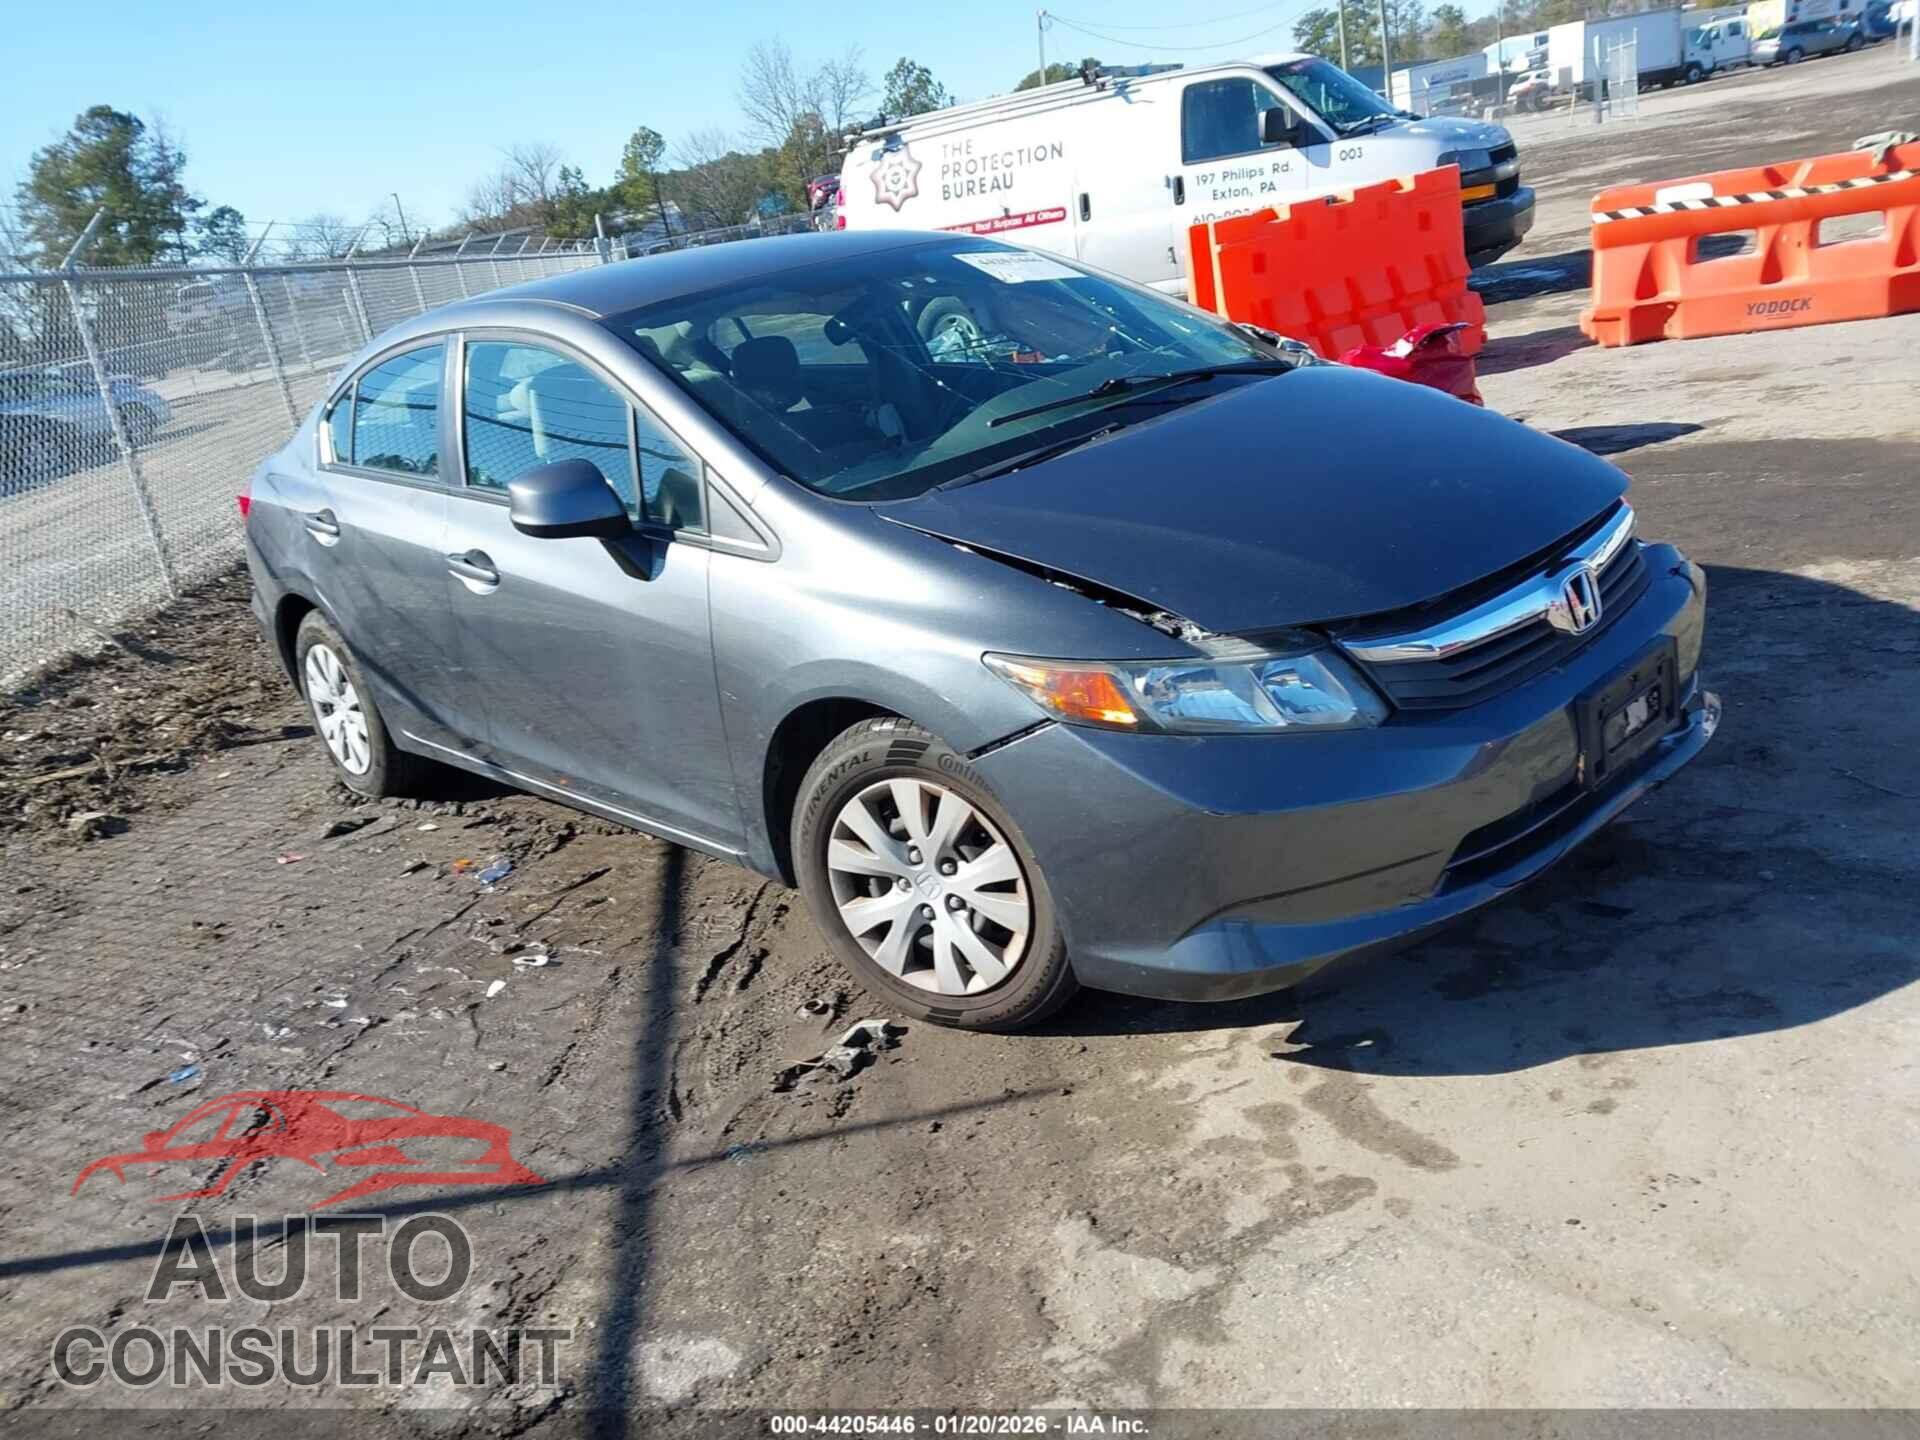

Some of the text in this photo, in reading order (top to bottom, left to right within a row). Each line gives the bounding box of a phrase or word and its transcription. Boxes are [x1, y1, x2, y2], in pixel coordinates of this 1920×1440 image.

[942, 139, 974, 159] THE
[1339, 147, 1363, 161] 003
[941, 141, 1064, 180] PROTECTION
[1195, 161, 1294, 186] 197 Philips Rd.
[942, 172, 1014, 201] BUREAU
[1212, 181, 1277, 201] Exton, PA
[1746, 297, 1812, 316] YODOCK
